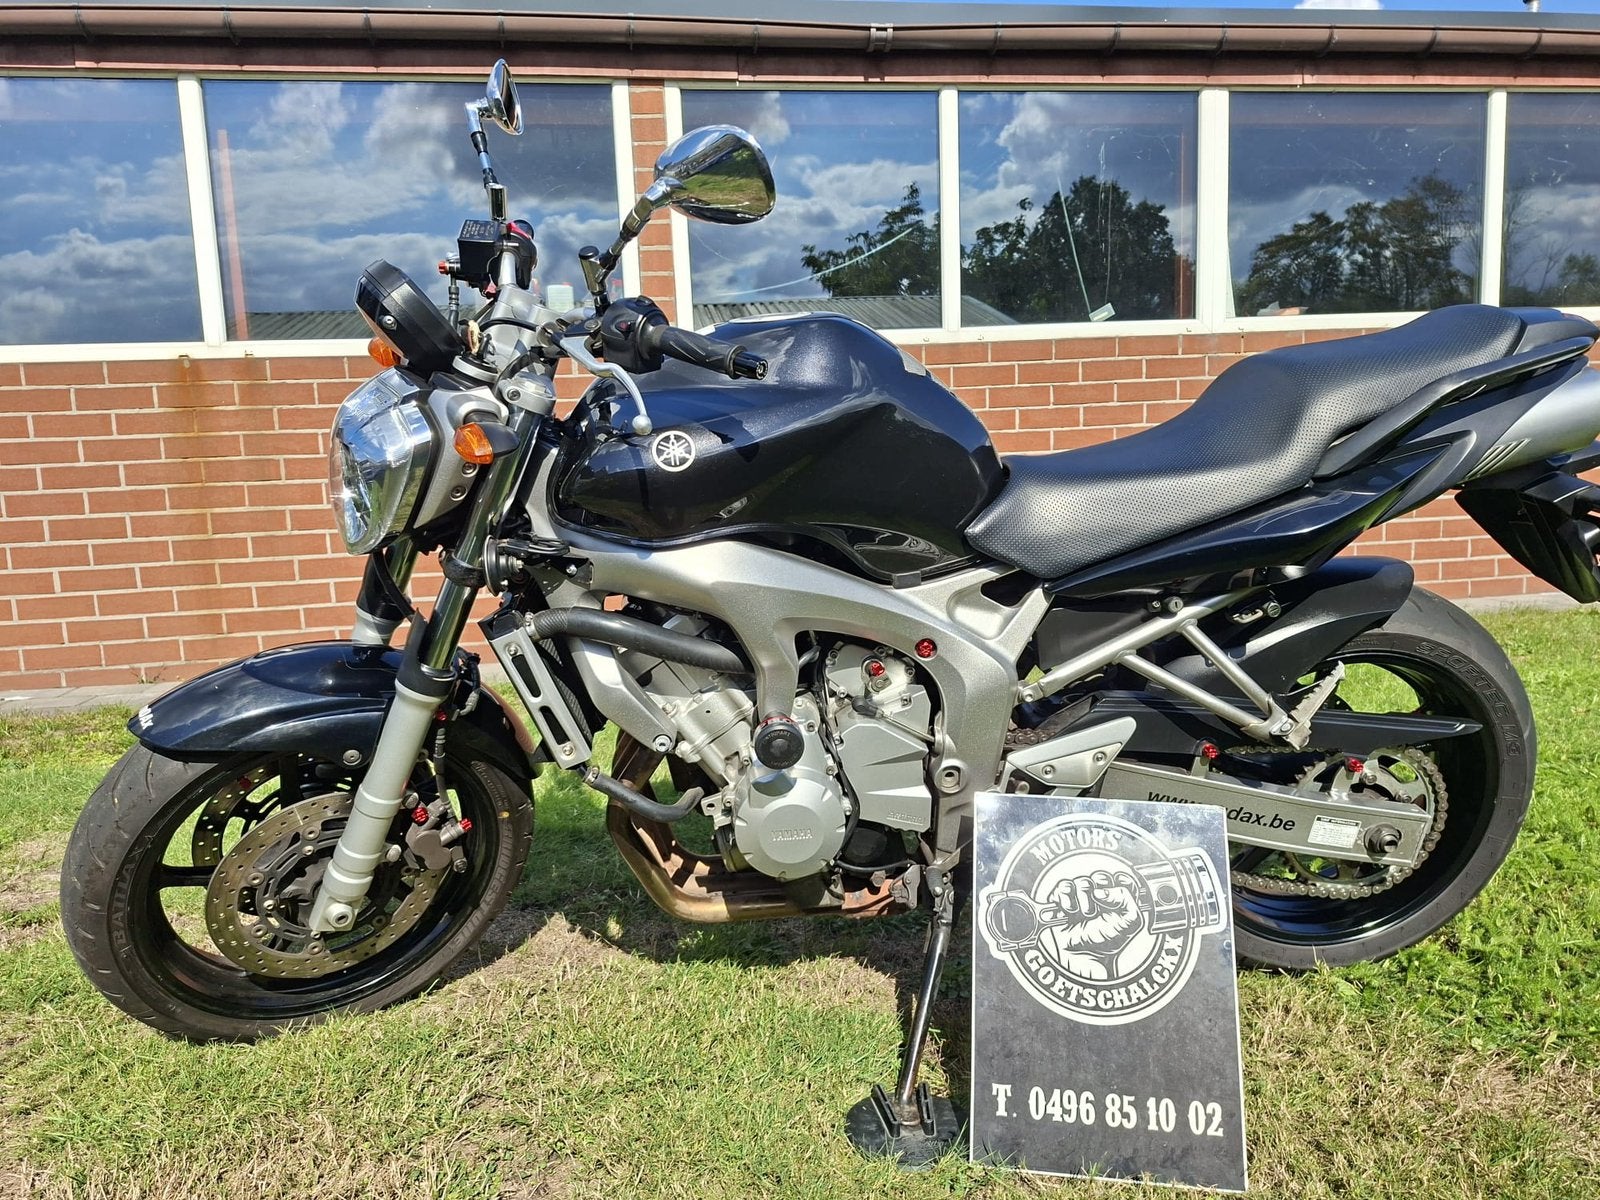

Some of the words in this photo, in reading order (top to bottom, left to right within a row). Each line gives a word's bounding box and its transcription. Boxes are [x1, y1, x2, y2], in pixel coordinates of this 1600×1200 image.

[1416, 641, 1511, 719] SPORTEC
[771, 829, 813, 841] YAMAHA
[1031, 828, 1122, 865] MOTORS
[1025, 936, 1184, 1011] GOETSCHALCKX
[992, 1083, 1017, 1118] T.
[1028, 1086, 1096, 1125] 0496
[1104, 1093, 1138, 1129] 85
[1147, 1097, 1177, 1132] 10
[1187, 1101, 1224, 1137] 02
